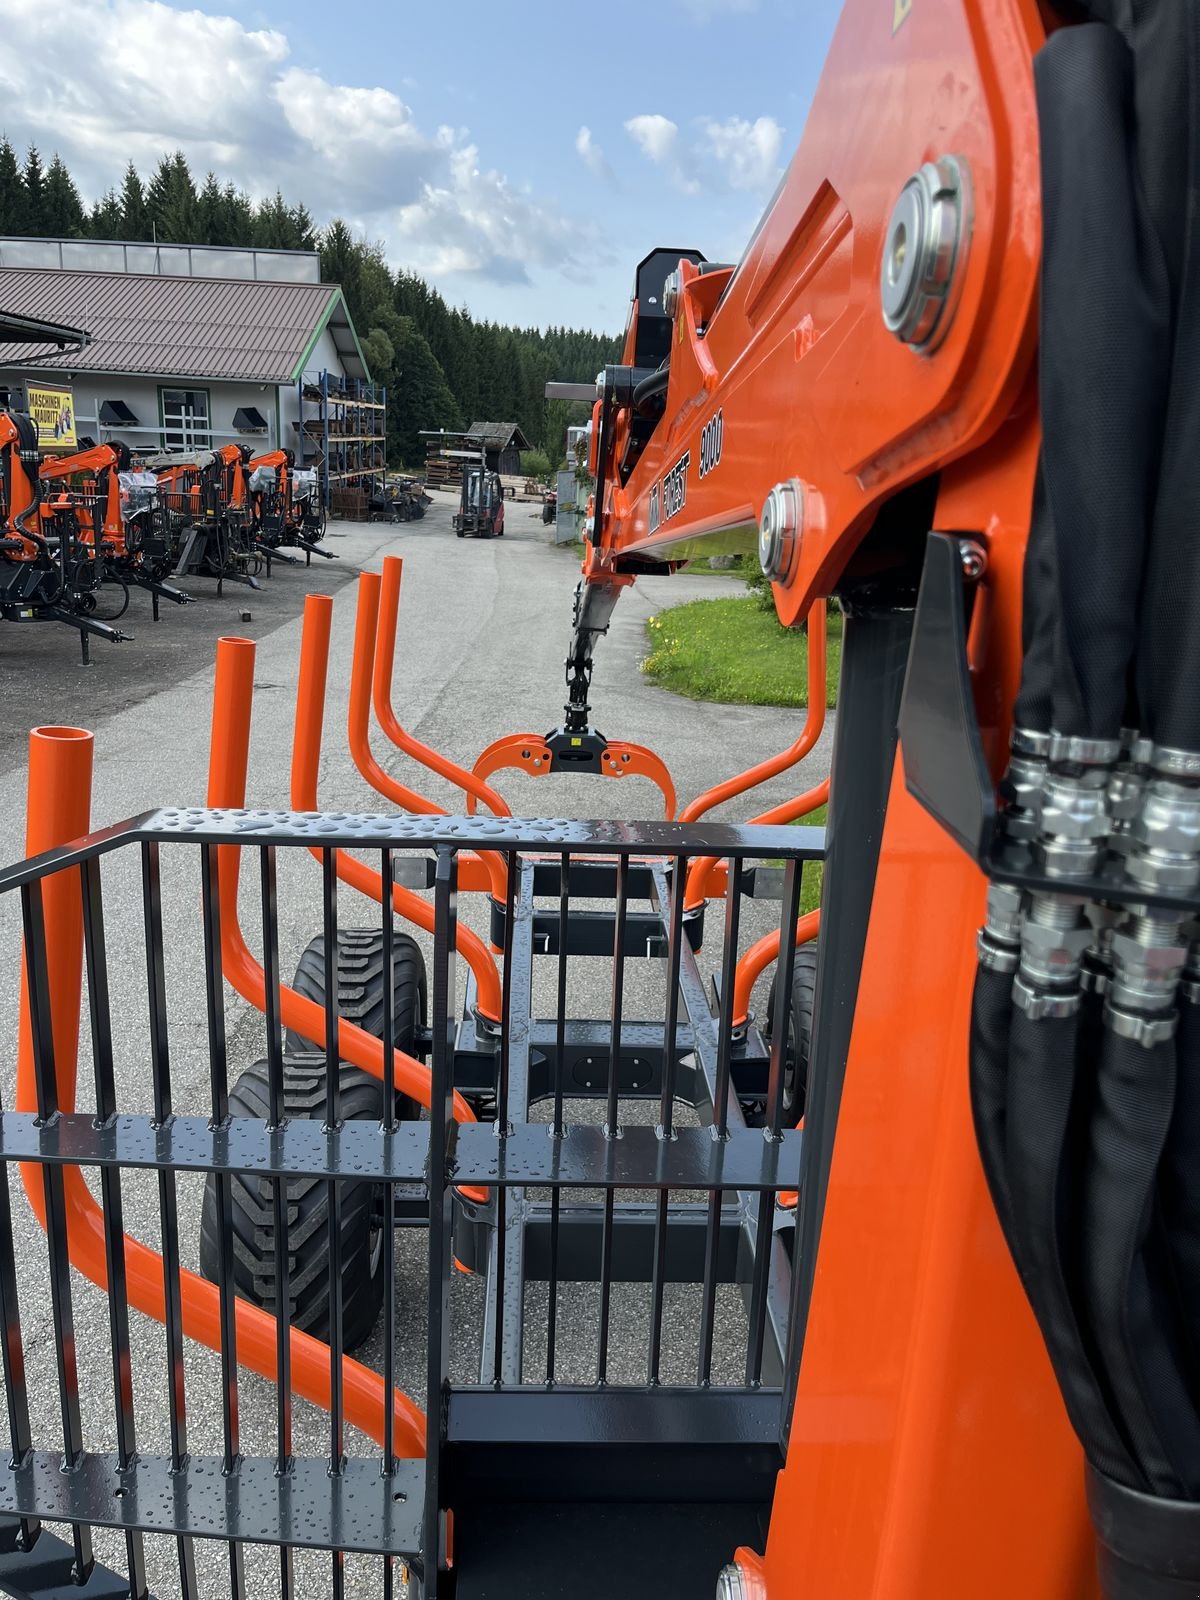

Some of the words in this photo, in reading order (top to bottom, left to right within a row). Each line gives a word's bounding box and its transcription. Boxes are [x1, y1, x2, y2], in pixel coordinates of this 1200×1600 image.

[29, 393, 60, 409] MASCHINEN
[34, 409, 58, 423] MAURITZ
[662, 449, 690, 524] FOREST
[699, 407, 723, 479] 9000
